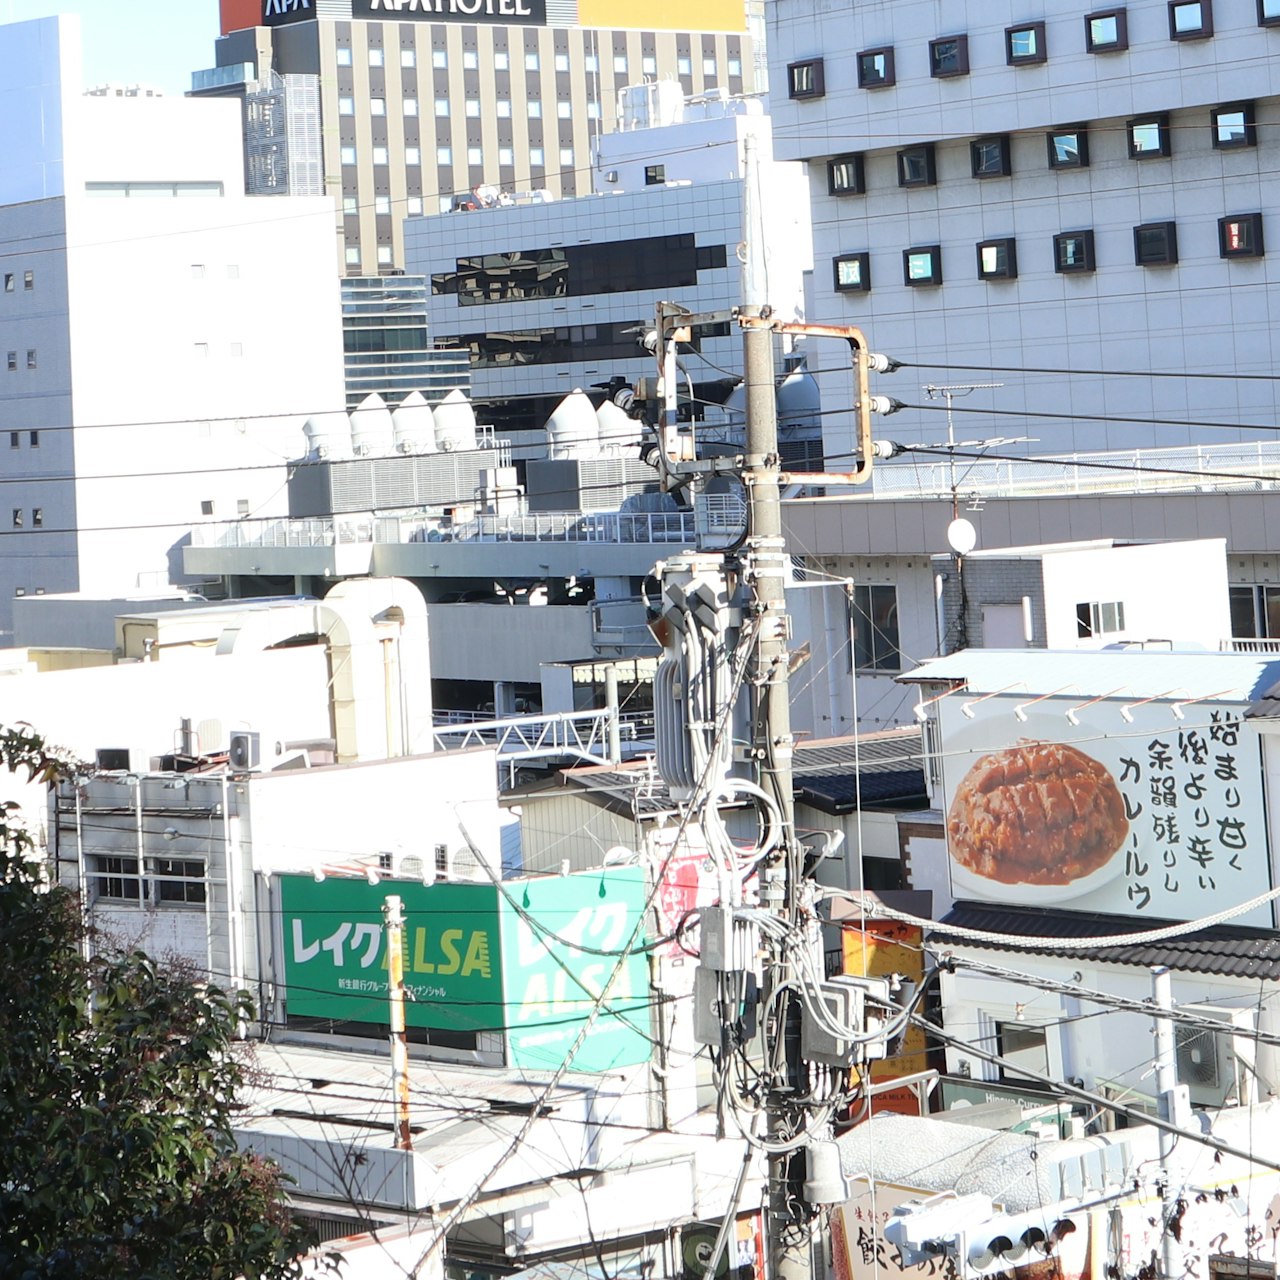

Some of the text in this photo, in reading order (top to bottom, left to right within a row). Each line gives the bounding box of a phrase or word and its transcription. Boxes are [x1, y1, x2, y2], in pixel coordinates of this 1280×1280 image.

[1119, 756, 1151, 910] カレールウ
[1148, 738, 1180, 893] 余韻残りし
[1178, 731, 1216, 891] 後より辛い
[1209, 710, 1247, 871] 始まり甘く
[291, 918, 381, 969] レイク
